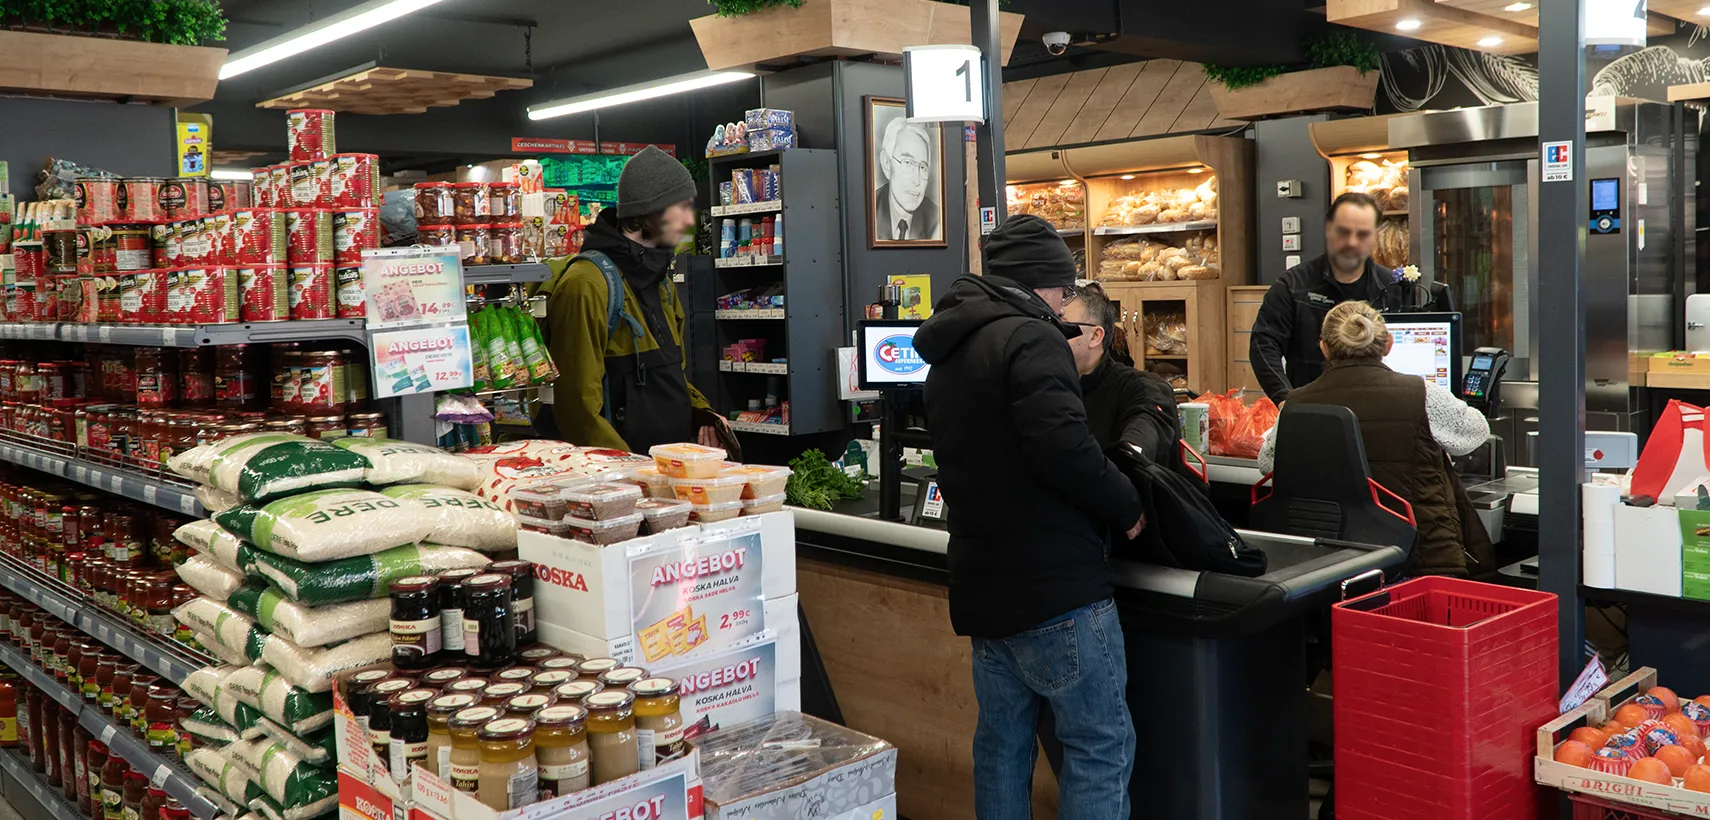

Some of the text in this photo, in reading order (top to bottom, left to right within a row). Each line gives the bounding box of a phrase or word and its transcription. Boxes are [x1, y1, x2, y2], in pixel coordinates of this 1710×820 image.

[956, 60, 972, 102] 1
[1548, 144, 1568, 164] EC
[380, 262, 444, 278] ANGEBOT
[388, 337, 456, 354] ANGEBOT
[306, 499, 400, 524] DERE
[650, 548, 746, 587] ANGEBOT
[682, 575, 739, 595] KOSKA HALVA
[719, 586, 736, 595] HELVA
[679, 657, 760, 696] NGEBOT
[695, 685, 752, 706] KOSKA HALVA
[716, 698, 742, 708] KAKAOLU
[455, 780, 474, 788] Tahin
[1580, 778, 1643, 797] BRIGHI
[688, 795, 694, 803] 2
